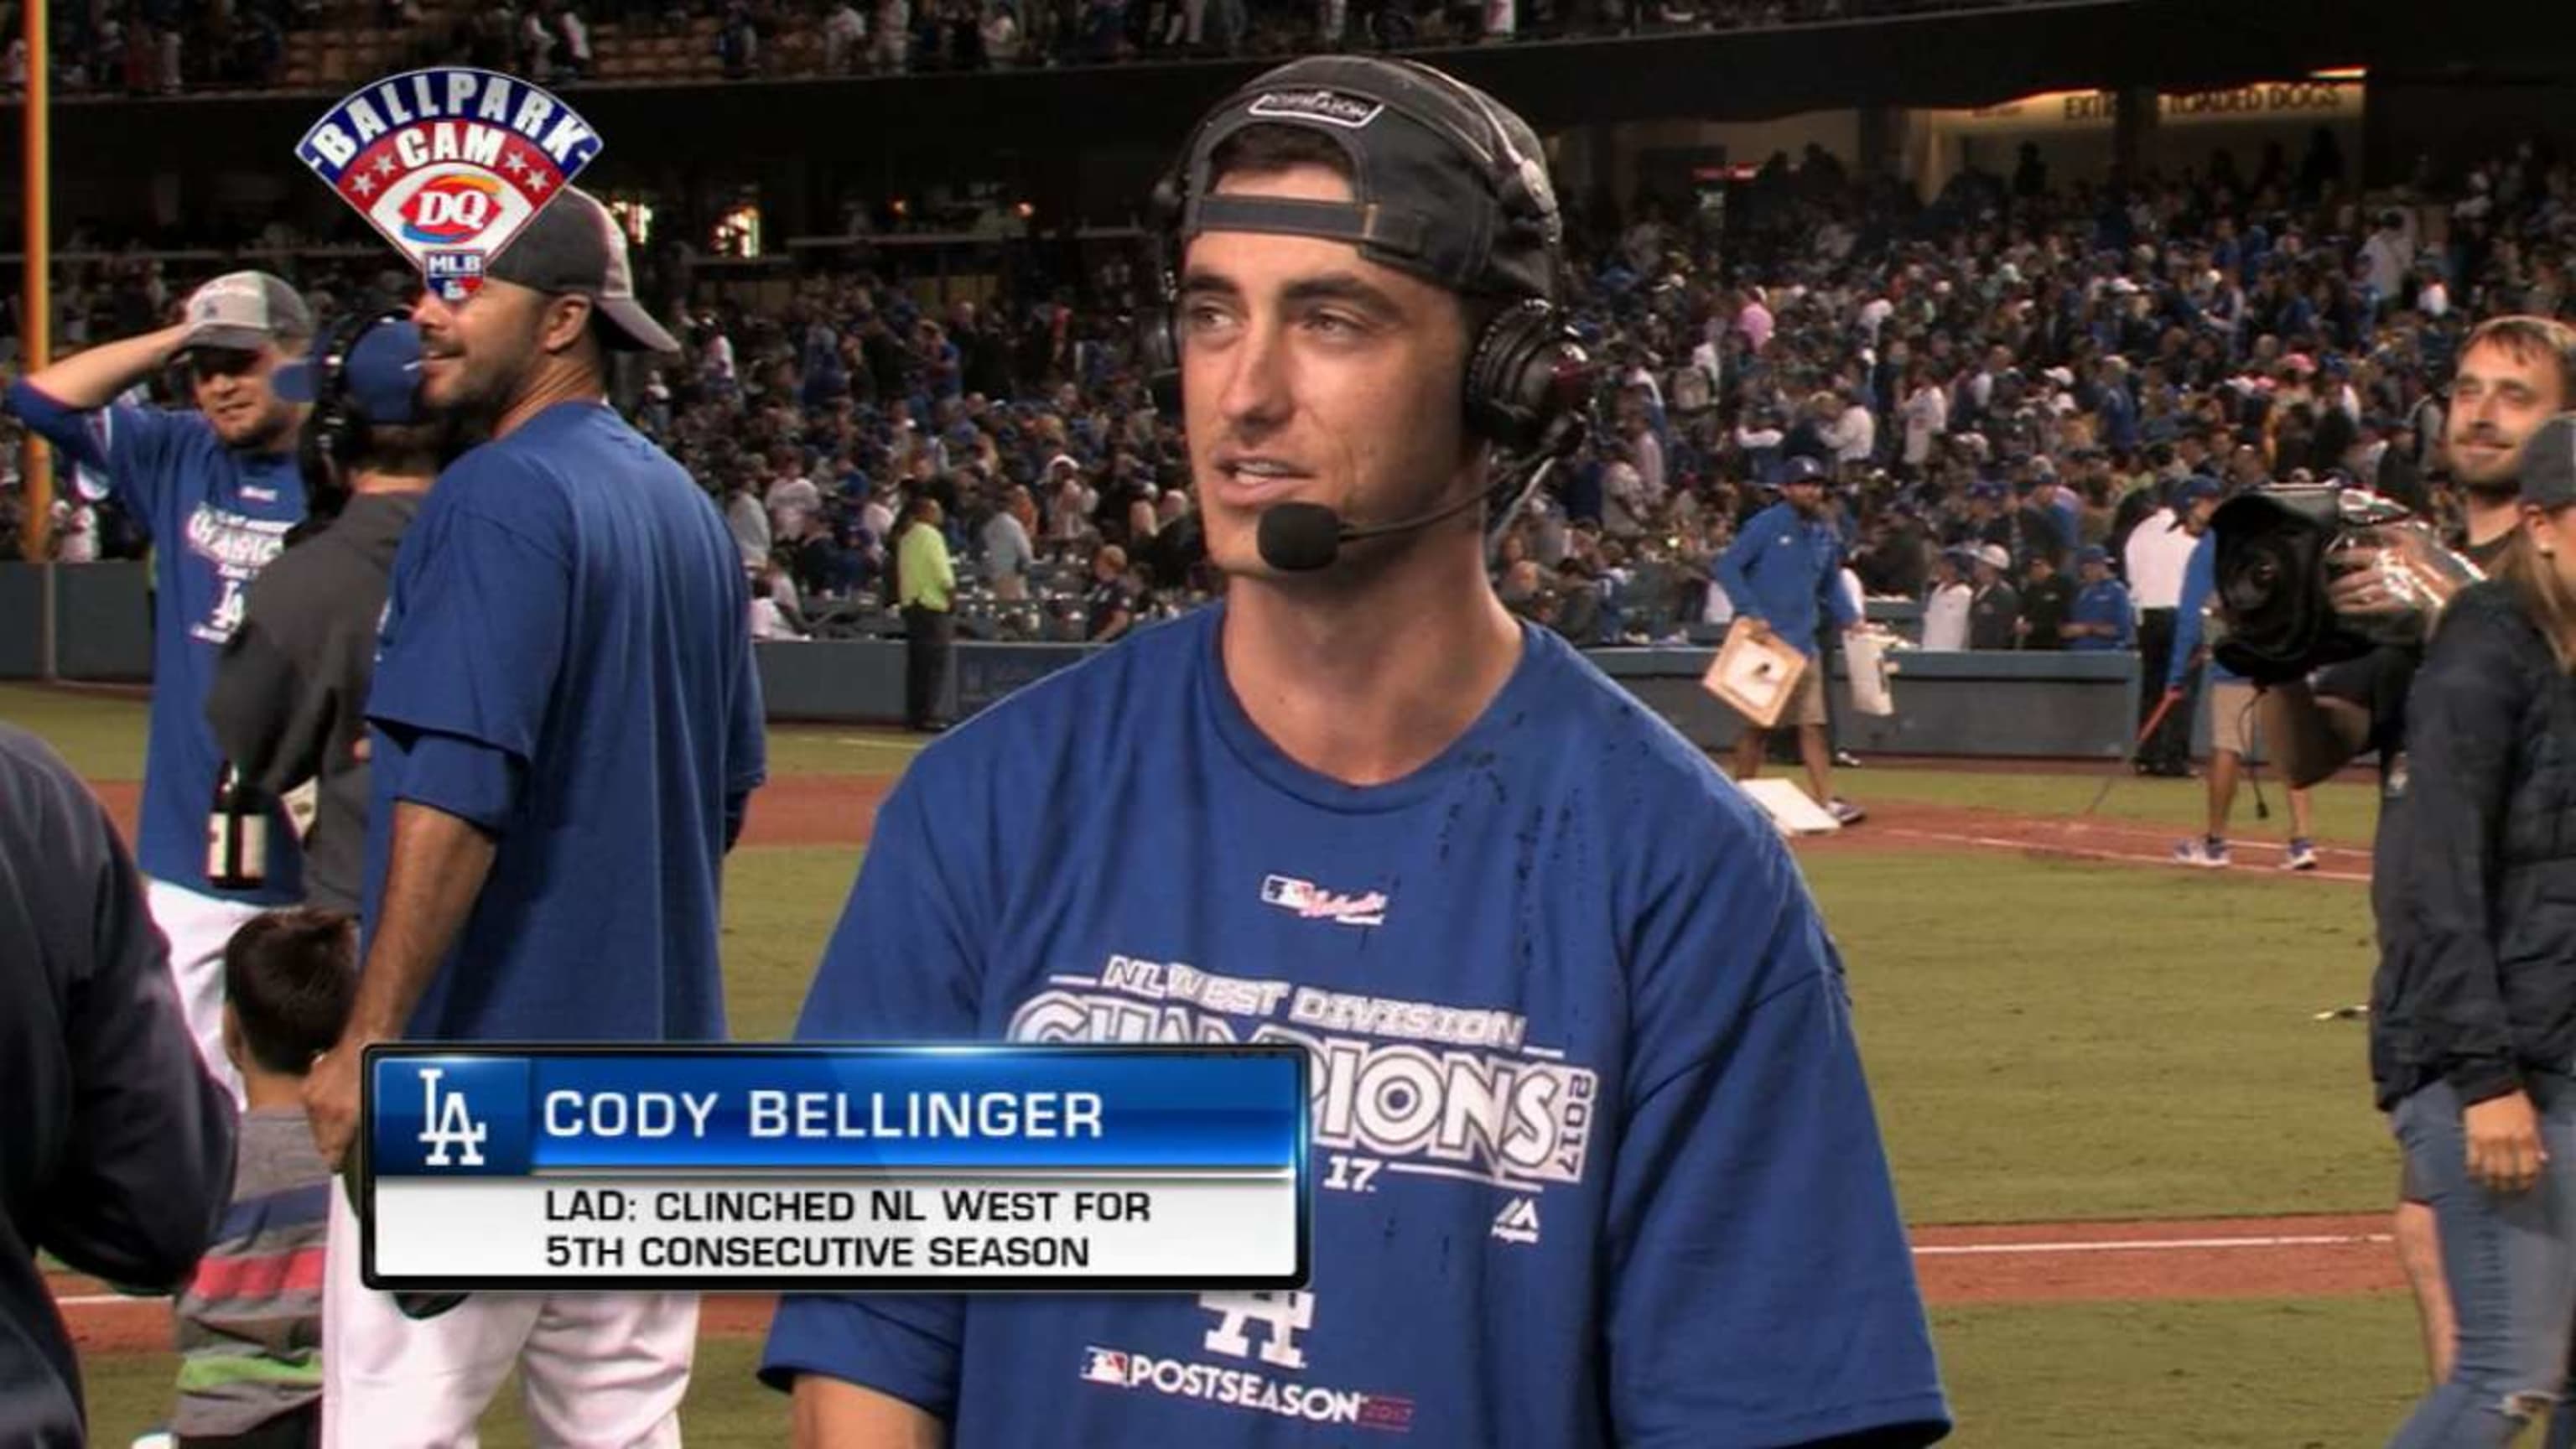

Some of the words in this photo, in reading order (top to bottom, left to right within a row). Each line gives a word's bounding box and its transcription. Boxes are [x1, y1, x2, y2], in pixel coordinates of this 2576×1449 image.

[2269, 82, 2340, 110] DOGS
[1167, 963, 1291, 1015] WEST
[1289, 985, 1527, 1047] DIVISION
[1557, 1073, 1592, 1174] 2017
[1130, 1353, 1361, 1422] POSTSEASON
